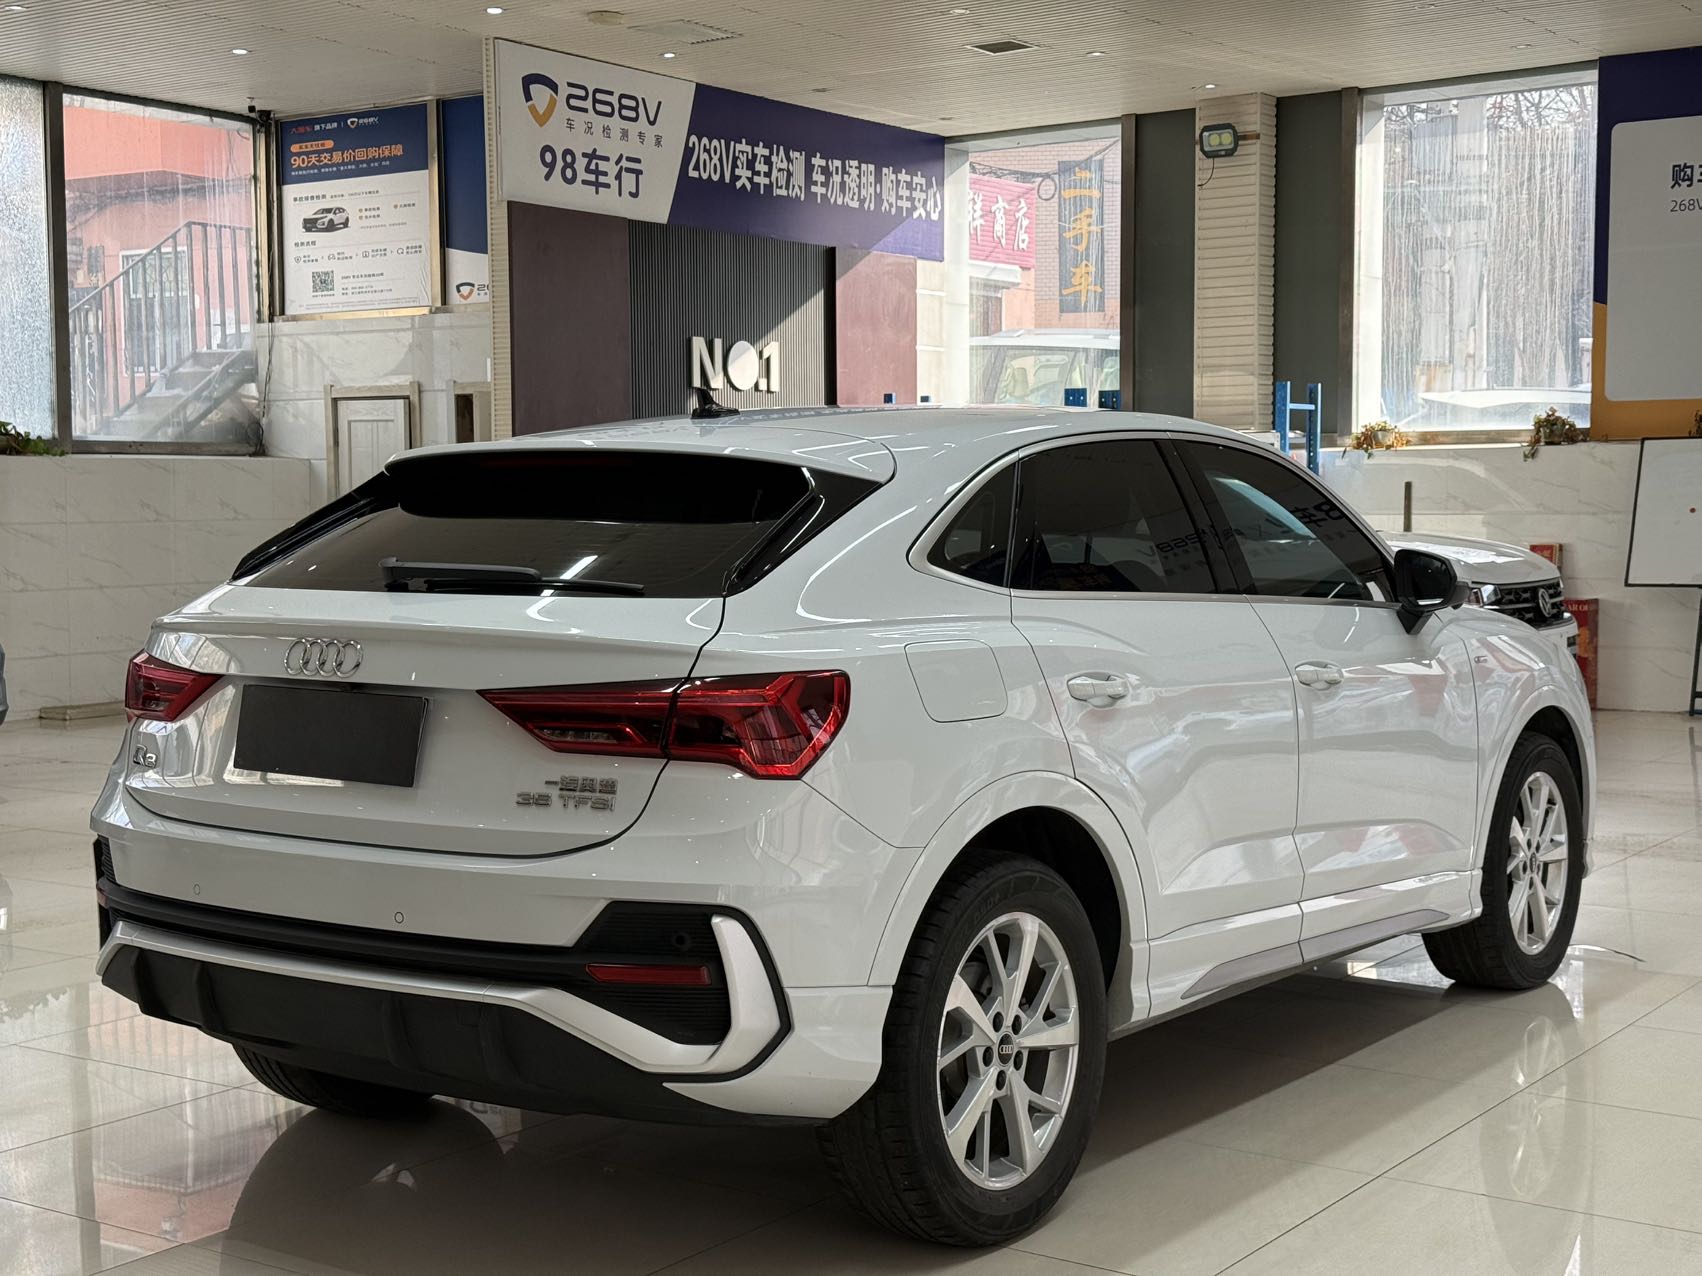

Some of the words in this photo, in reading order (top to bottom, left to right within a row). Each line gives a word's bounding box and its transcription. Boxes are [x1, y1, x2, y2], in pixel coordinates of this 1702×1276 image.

[565, 81, 662, 127] 268V
[290, 143, 404, 168] 90天交易价回购保障
[565, 117, 664, 148] 车况检测专家
[539, 144, 643, 199] 98车行
[687, 134, 806, 202] 268V实车检测
[810, 152, 942, 221] 车况透明·购车安心
[1062, 166, 1105, 307] 二手车
[133, 744, 158, 768] Q3
